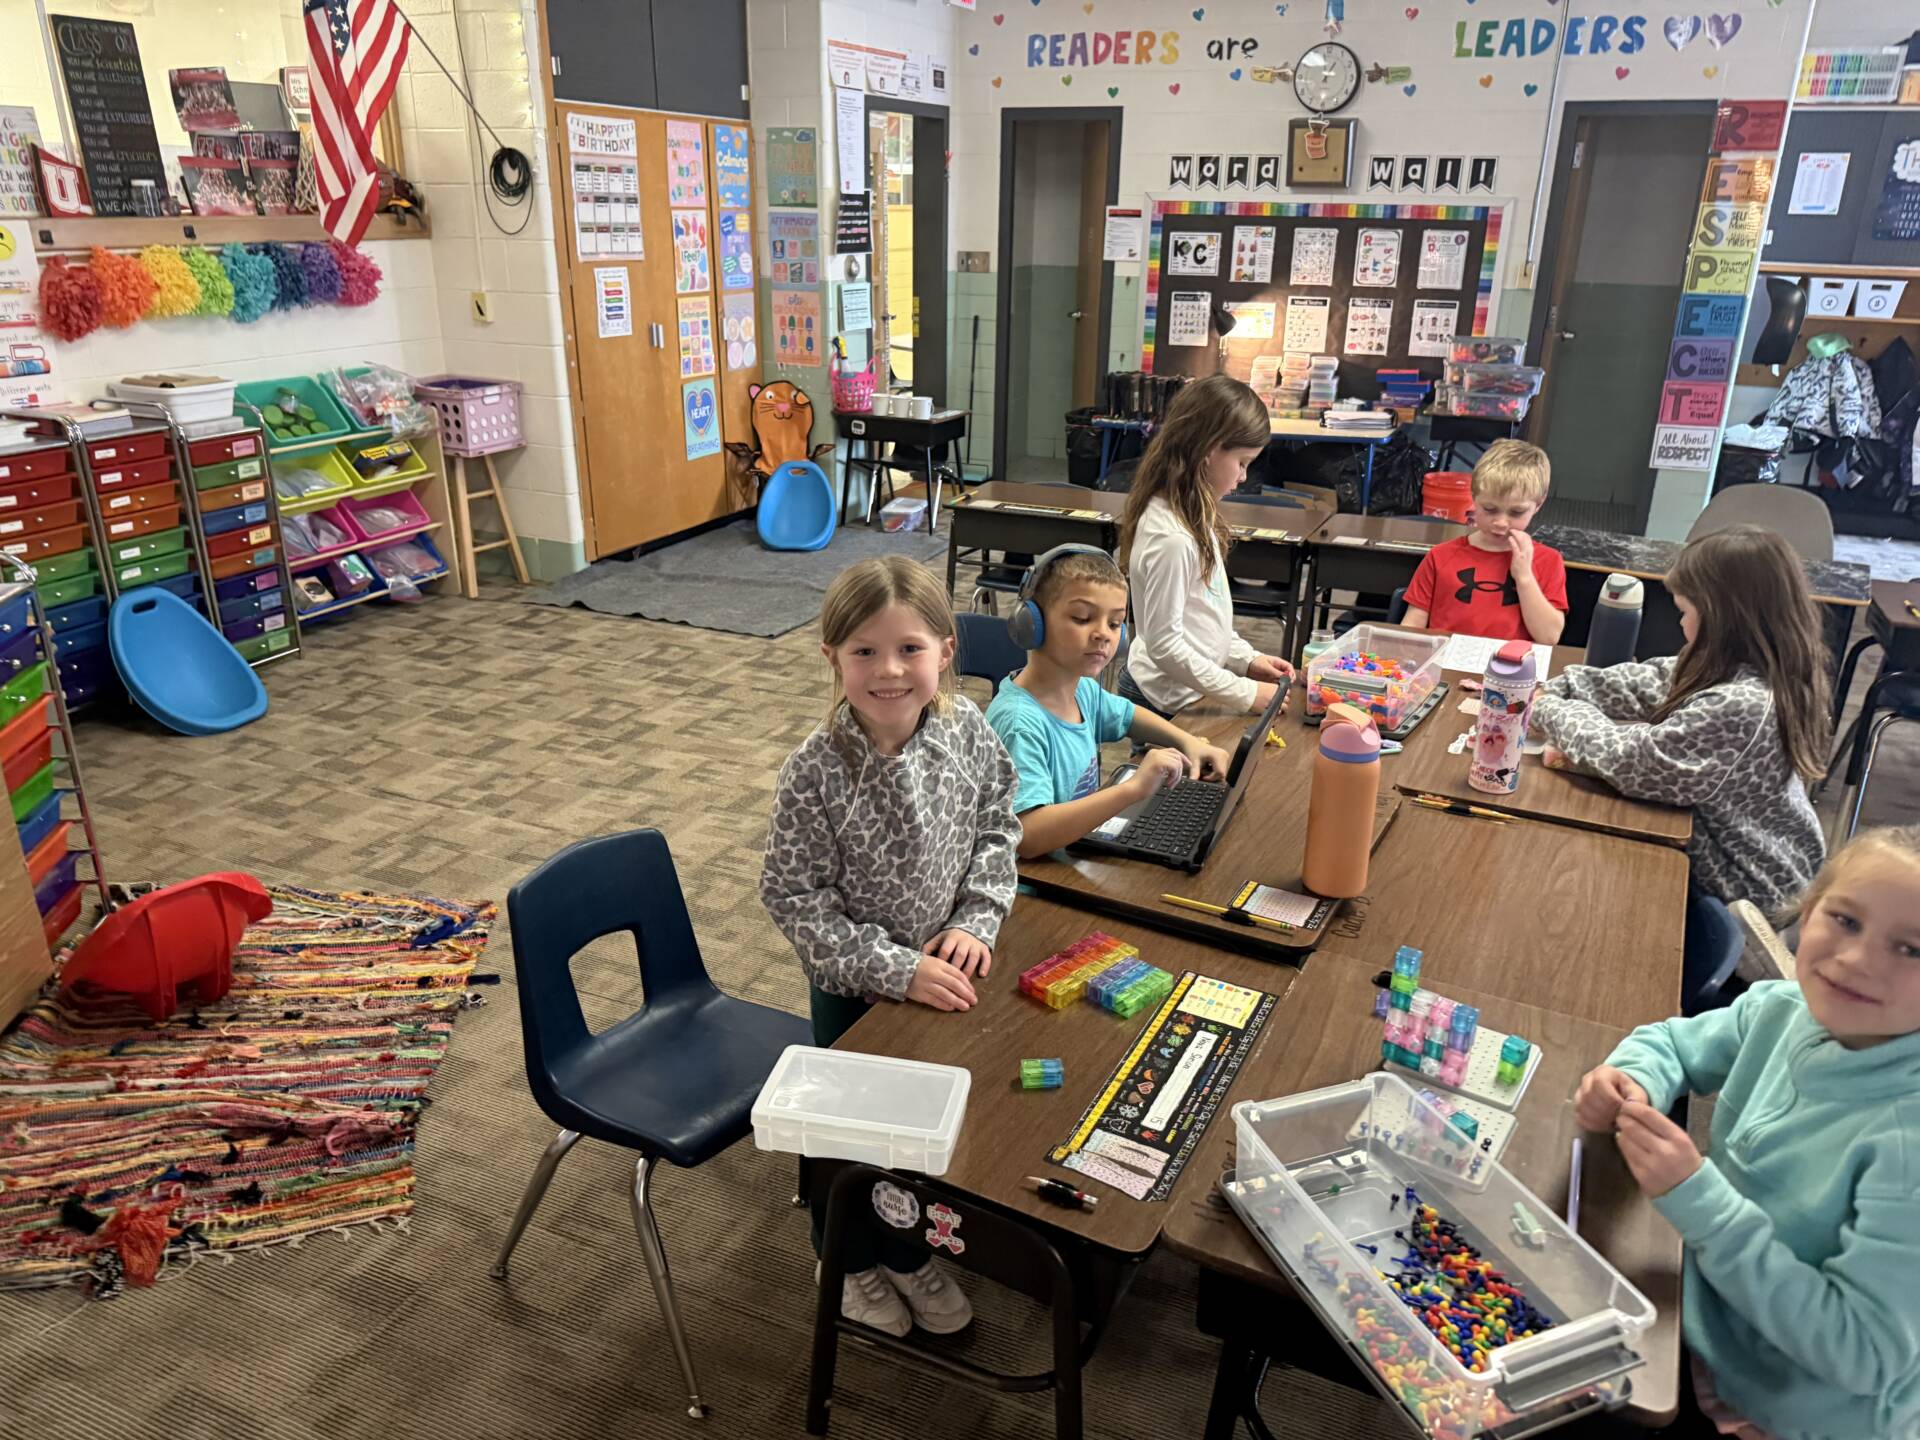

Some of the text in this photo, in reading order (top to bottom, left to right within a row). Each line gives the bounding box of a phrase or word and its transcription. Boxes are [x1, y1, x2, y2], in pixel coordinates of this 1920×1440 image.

[1027, 16, 1648, 67] READERS are LEADERS
[587, 122, 620, 137] HAPPY
[1718, 105, 1749, 146] R
[579, 135, 630, 152] BIRTHDAY
[717, 149, 749, 174] Calming
[1172, 159, 1486, 181] Word Wall
[1707, 164, 1738, 202] E
[1698, 209, 1727, 247] S
[1193, 243, 1207, 265] C
[1688, 255, 1718, 291] P
[1680, 299, 1710, 336] E
[1672, 344, 1698, 378] C
[691, 405, 711, 419] HEART
[1667, 387, 1692, 421] T
[1661, 433, 1707, 445] All About
[1657, 446, 1711, 461] RESPECT
[928, 1205, 962, 1228] BEAT
